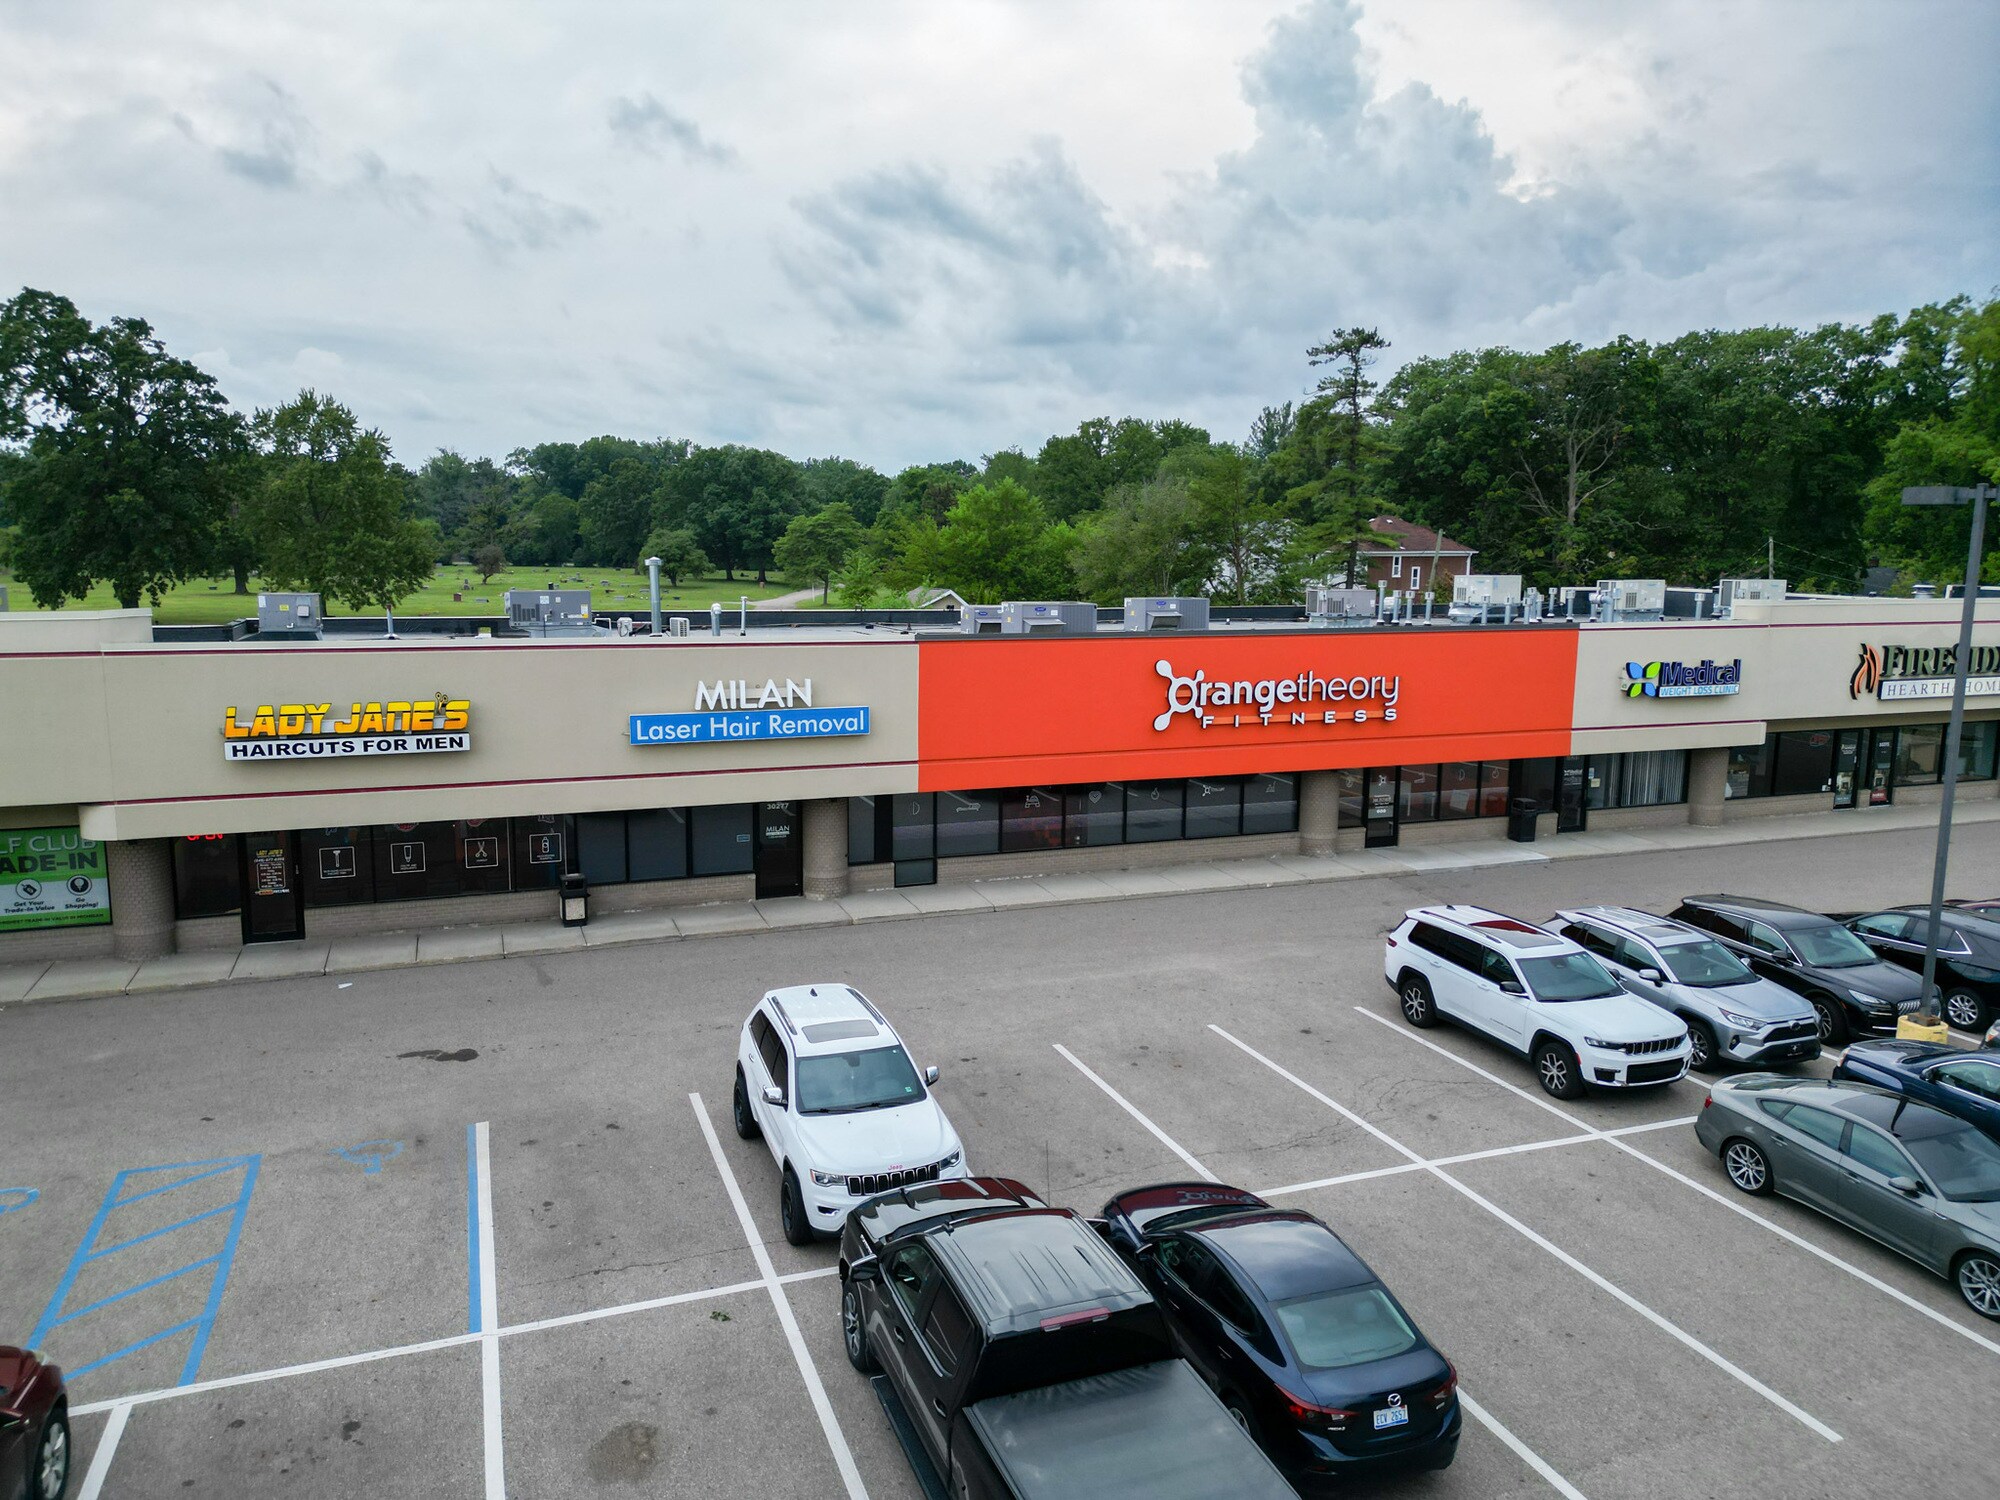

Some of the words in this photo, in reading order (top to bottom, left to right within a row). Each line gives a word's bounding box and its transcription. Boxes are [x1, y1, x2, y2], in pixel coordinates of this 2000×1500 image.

[1660, 659, 1741, 686] Medical
[1881, 644, 2000, 677] FIREID
[695, 678, 812, 710] MILAN
[1661, 687, 1691, 696] WEIGHT
[1694, 686, 1712, 695] LOSS
[1715, 685, 1737, 694] CLINIC
[1887, 682, 1950, 696] HEARTH
[224, 703, 331, 738] LADY
[636, 719, 701, 741] Laser
[710, 715, 761, 738] Hair
[769, 710, 864, 735] Removal
[1202, 708, 1397, 729] FITNESS
[232, 740, 355, 757] HAIRCUTS
[363, 738, 408, 753] FOR
[416, 736, 464, 750] MEN
